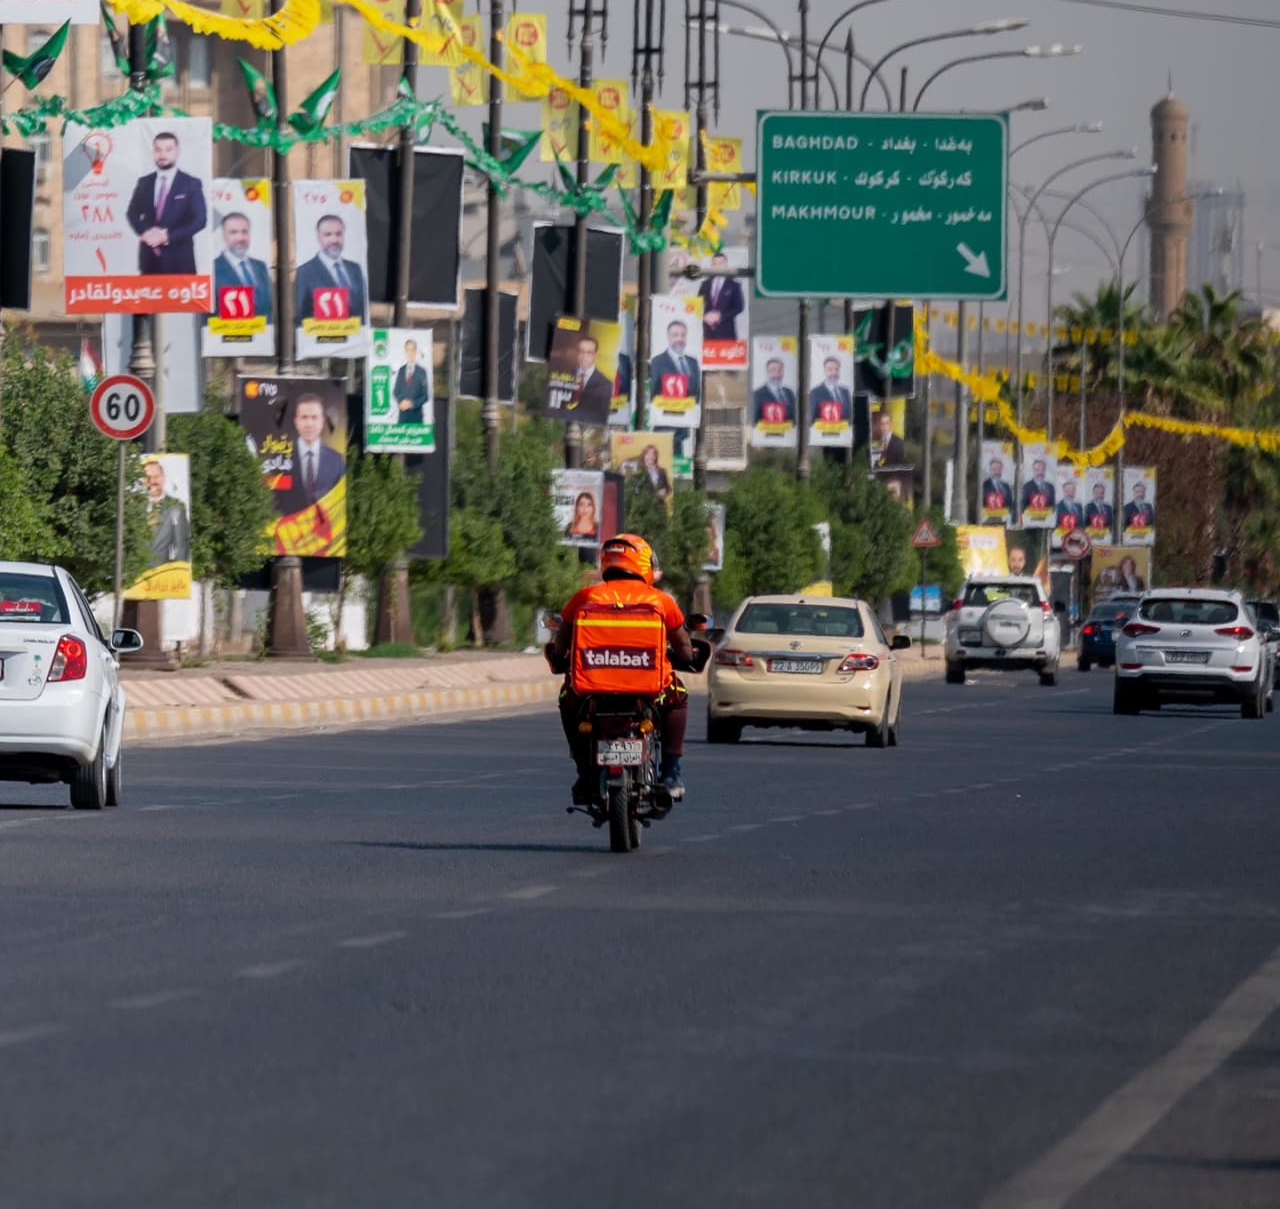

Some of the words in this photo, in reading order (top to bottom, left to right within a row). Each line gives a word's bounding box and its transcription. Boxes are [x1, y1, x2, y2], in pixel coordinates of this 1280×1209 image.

[771, 134, 859, 151] BAGHDAD
[771, 170, 838, 186] KIRKUK
[771, 205, 877, 221] MAKHMOUR
[68, 283, 165, 306] عەبدولقادر
[167, 283, 209, 305] کاوە
[105, 392, 141, 422] 60
[584, 649, 651, 668] talabat
